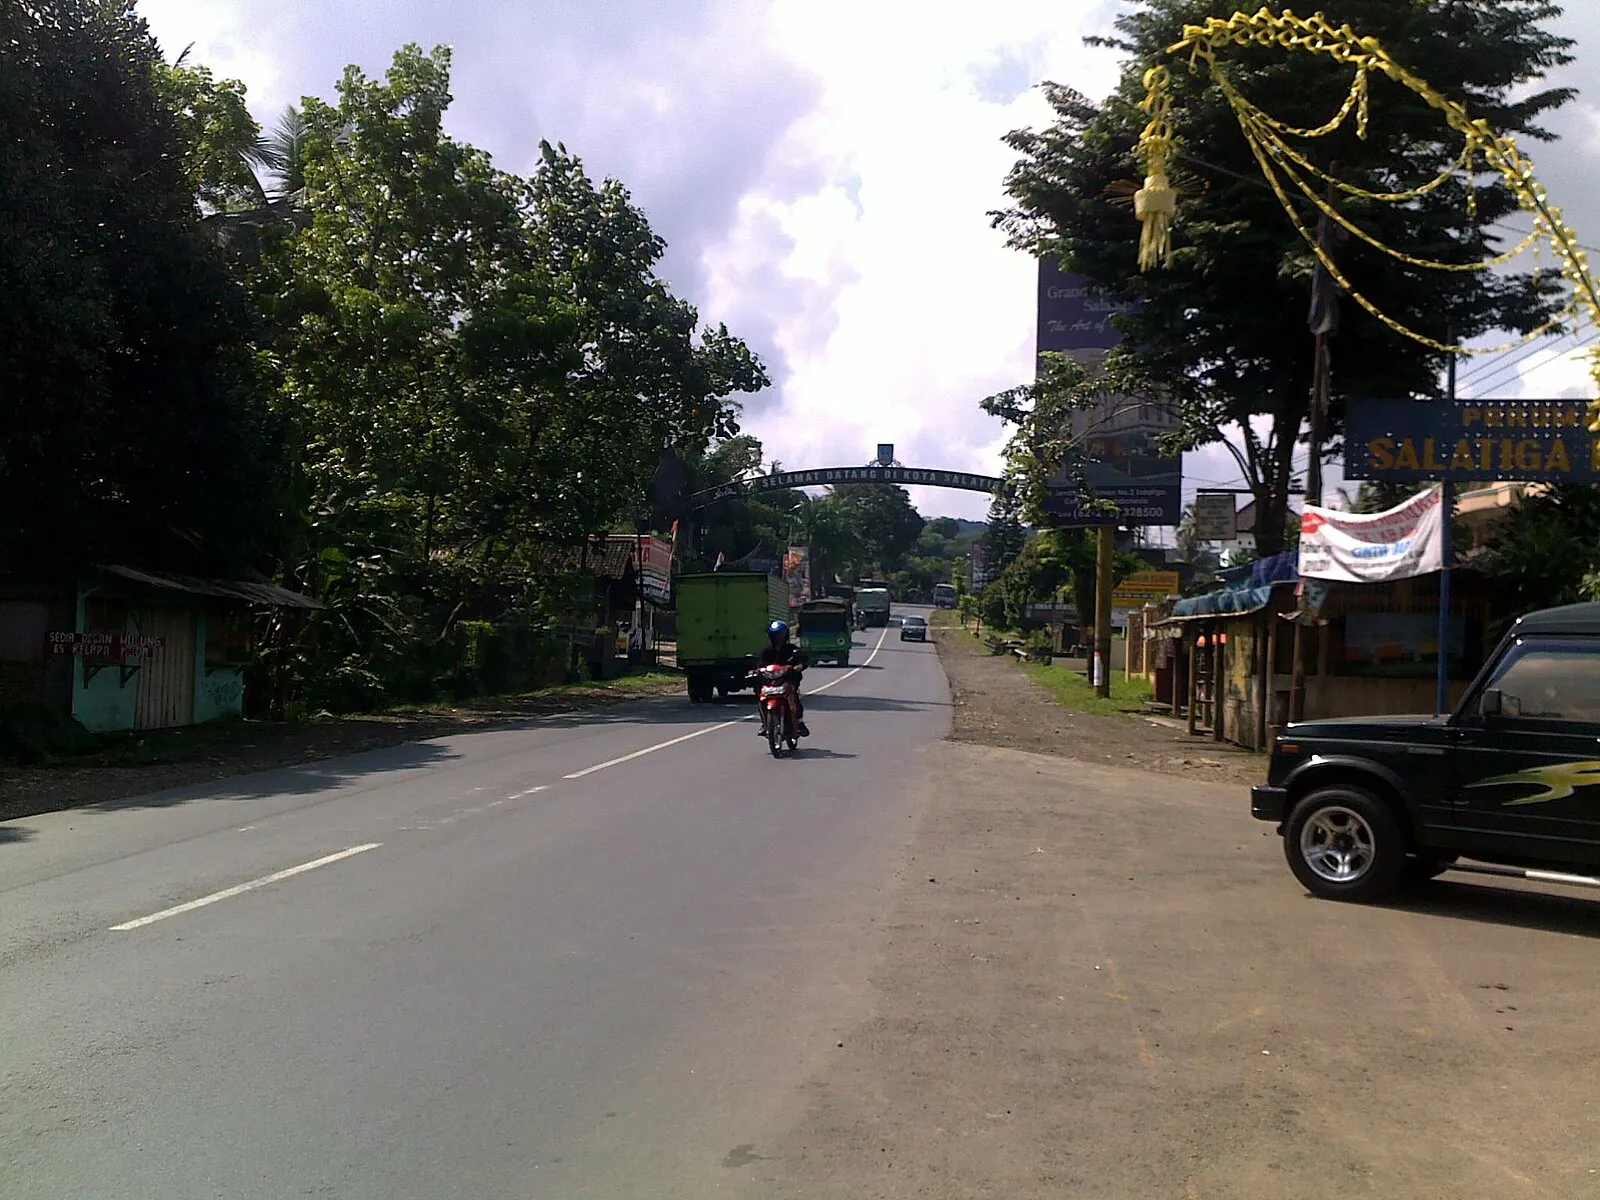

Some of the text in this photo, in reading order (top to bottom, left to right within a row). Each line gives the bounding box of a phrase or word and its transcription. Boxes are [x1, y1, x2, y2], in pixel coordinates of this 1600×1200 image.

[1367, 437, 1573, 472] SALATIGA
[761, 472, 820, 489] SELAMAT
[826, 469, 877, 480] DATANG
[884, 469, 897, 480] DI
[903, 469, 936, 482] KOTA
[53, 643, 65, 654] ES
